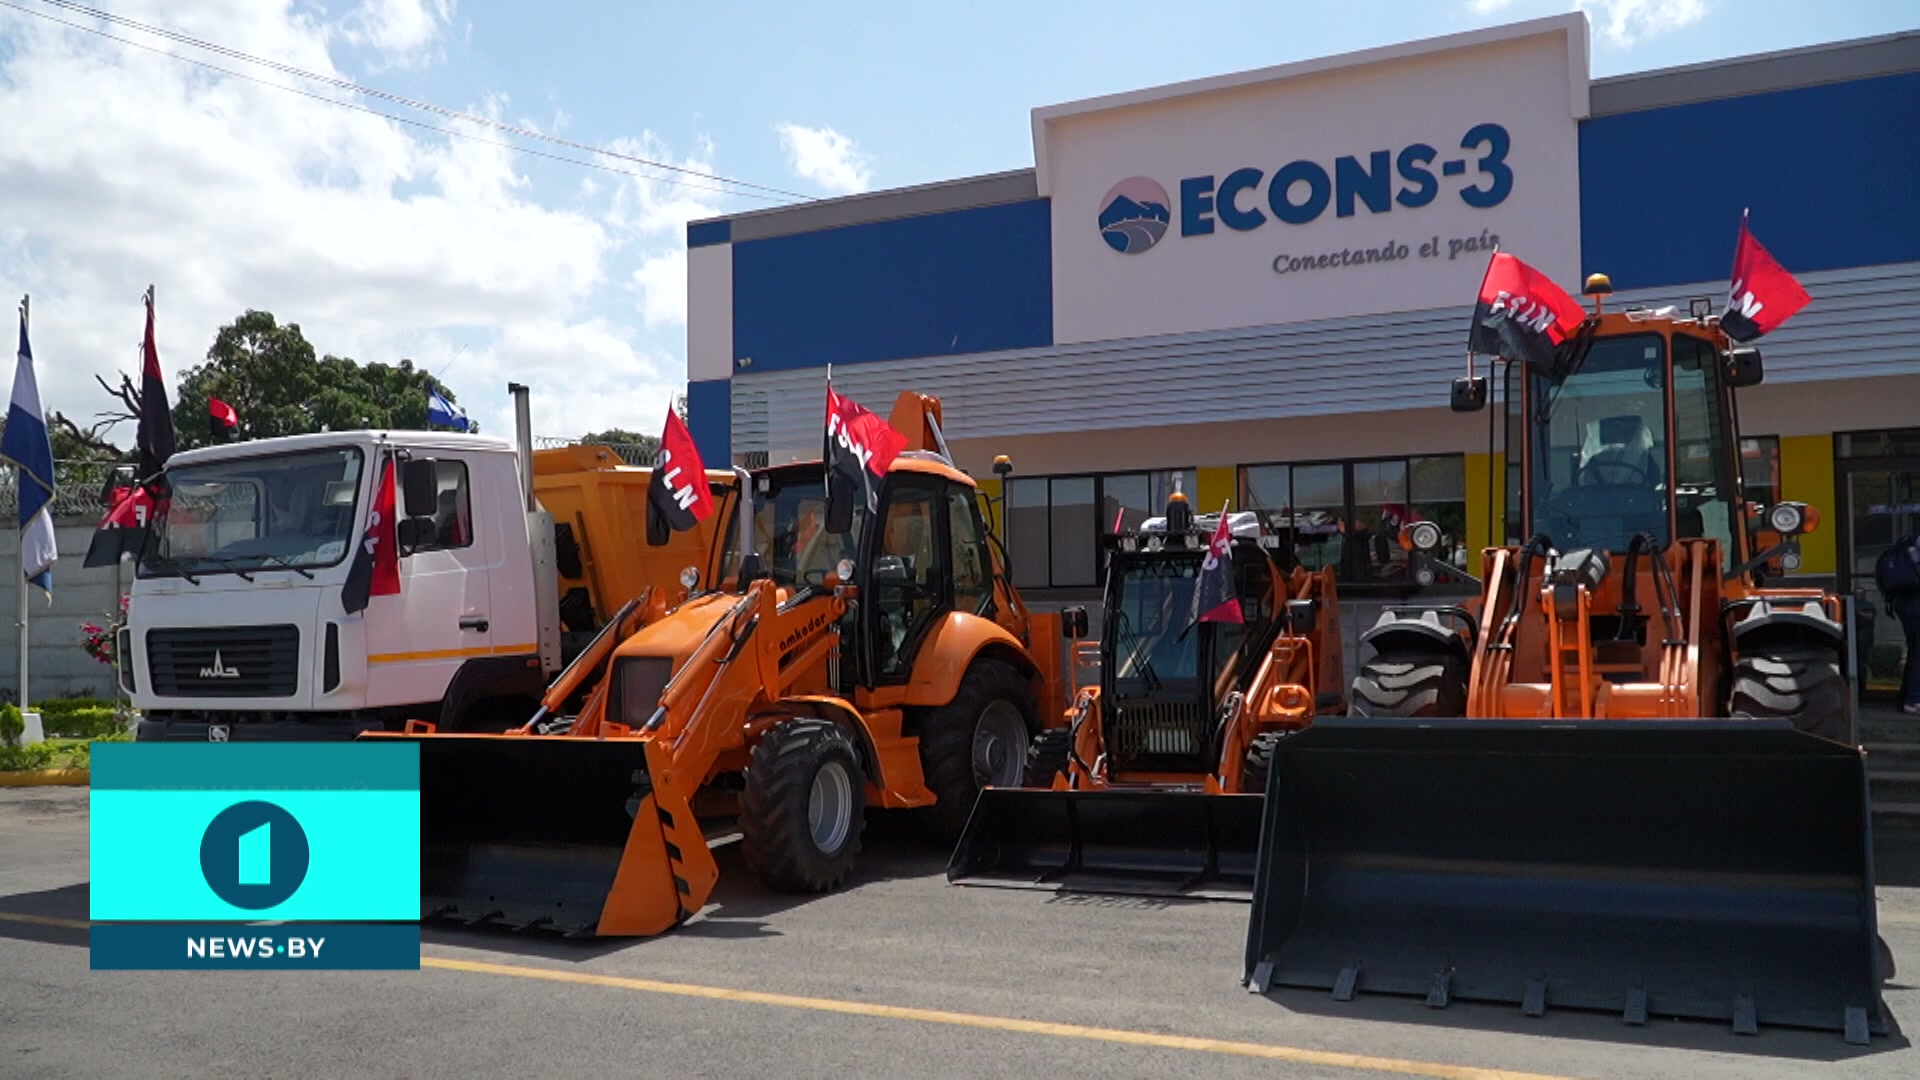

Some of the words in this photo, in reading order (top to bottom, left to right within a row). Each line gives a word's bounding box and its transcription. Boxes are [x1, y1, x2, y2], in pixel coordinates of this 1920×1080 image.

[1181, 123, 1514, 237] ECONS-3
[1273, 244, 1410, 275] Conectando
[1419, 238, 1439, 258] el
